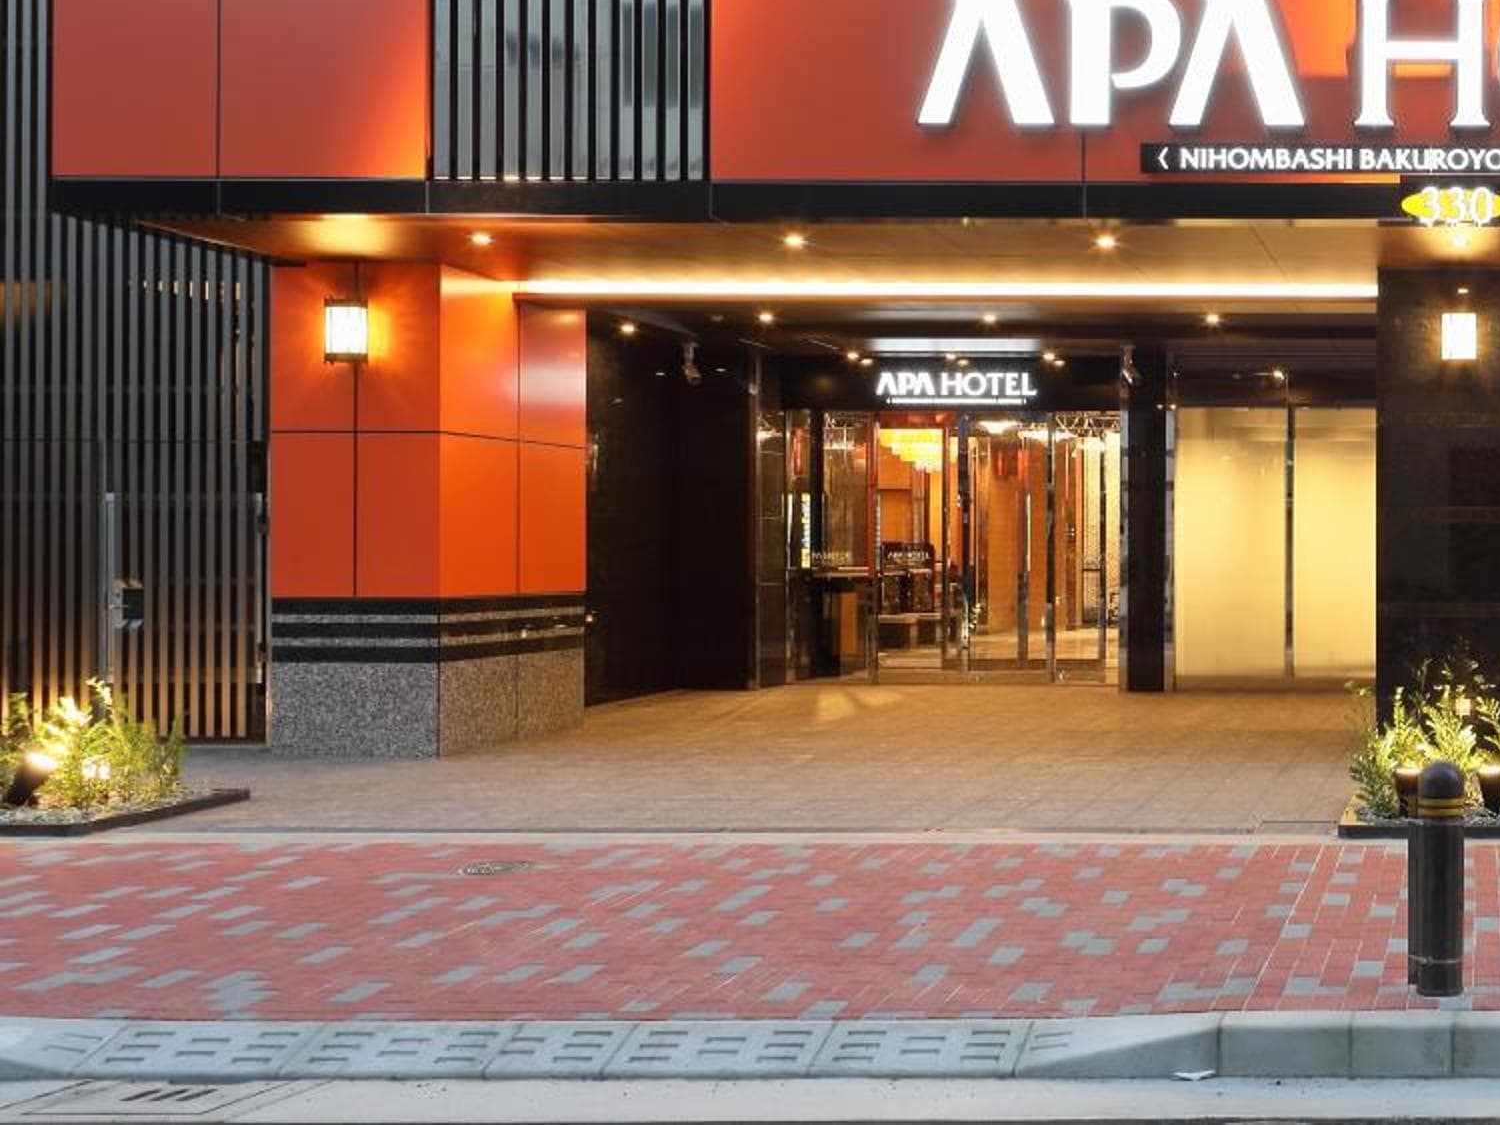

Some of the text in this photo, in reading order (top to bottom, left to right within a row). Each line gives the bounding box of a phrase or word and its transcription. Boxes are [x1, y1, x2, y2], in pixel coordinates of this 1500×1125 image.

[1178, 146, 1354, 171] NIHOMBASHI
[1418, 186, 1493, 222] 330
[875, 371, 1037, 396] APA HOTEL
